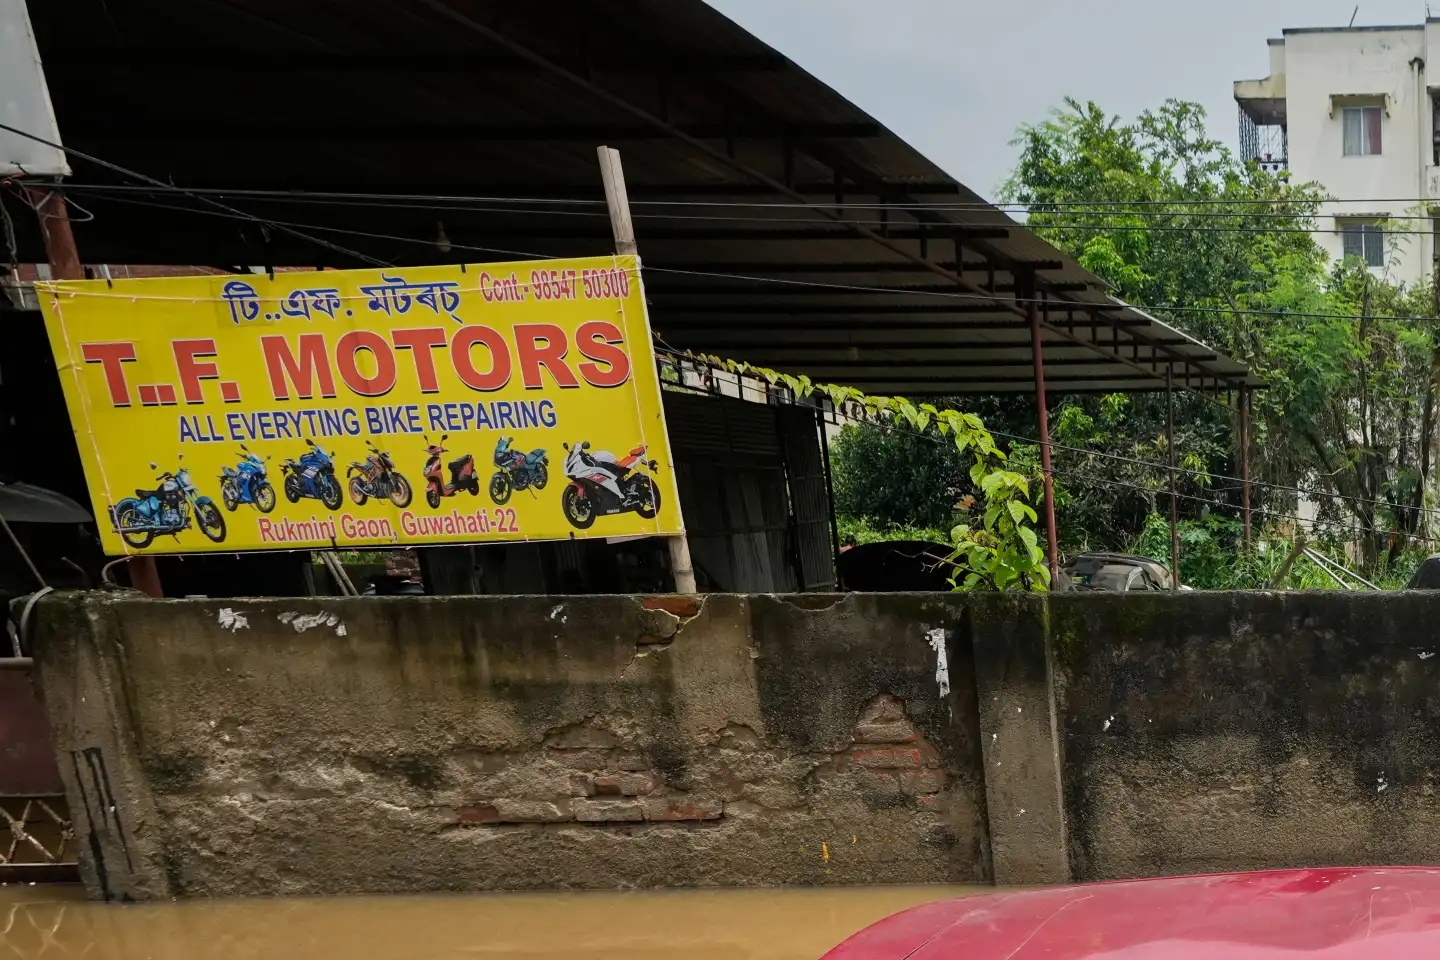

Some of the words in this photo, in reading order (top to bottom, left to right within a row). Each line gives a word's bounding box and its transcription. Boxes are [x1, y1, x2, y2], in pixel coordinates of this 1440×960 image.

[531, 269, 577, 300] 98547
[582, 268, 629, 299] 50300
[260, 320, 631, 401] MOTORS
[180, 415, 224, 443] ALL
[226, 408, 361, 440] EVERYTING
[366, 405, 423, 435] BIKE
[428, 399, 557, 431] REPAIRING
[258, 515, 337, 542] Rukmini
[341, 514, 398, 541] Gaon,
[401, 508, 519, 536] Guwahati-22
